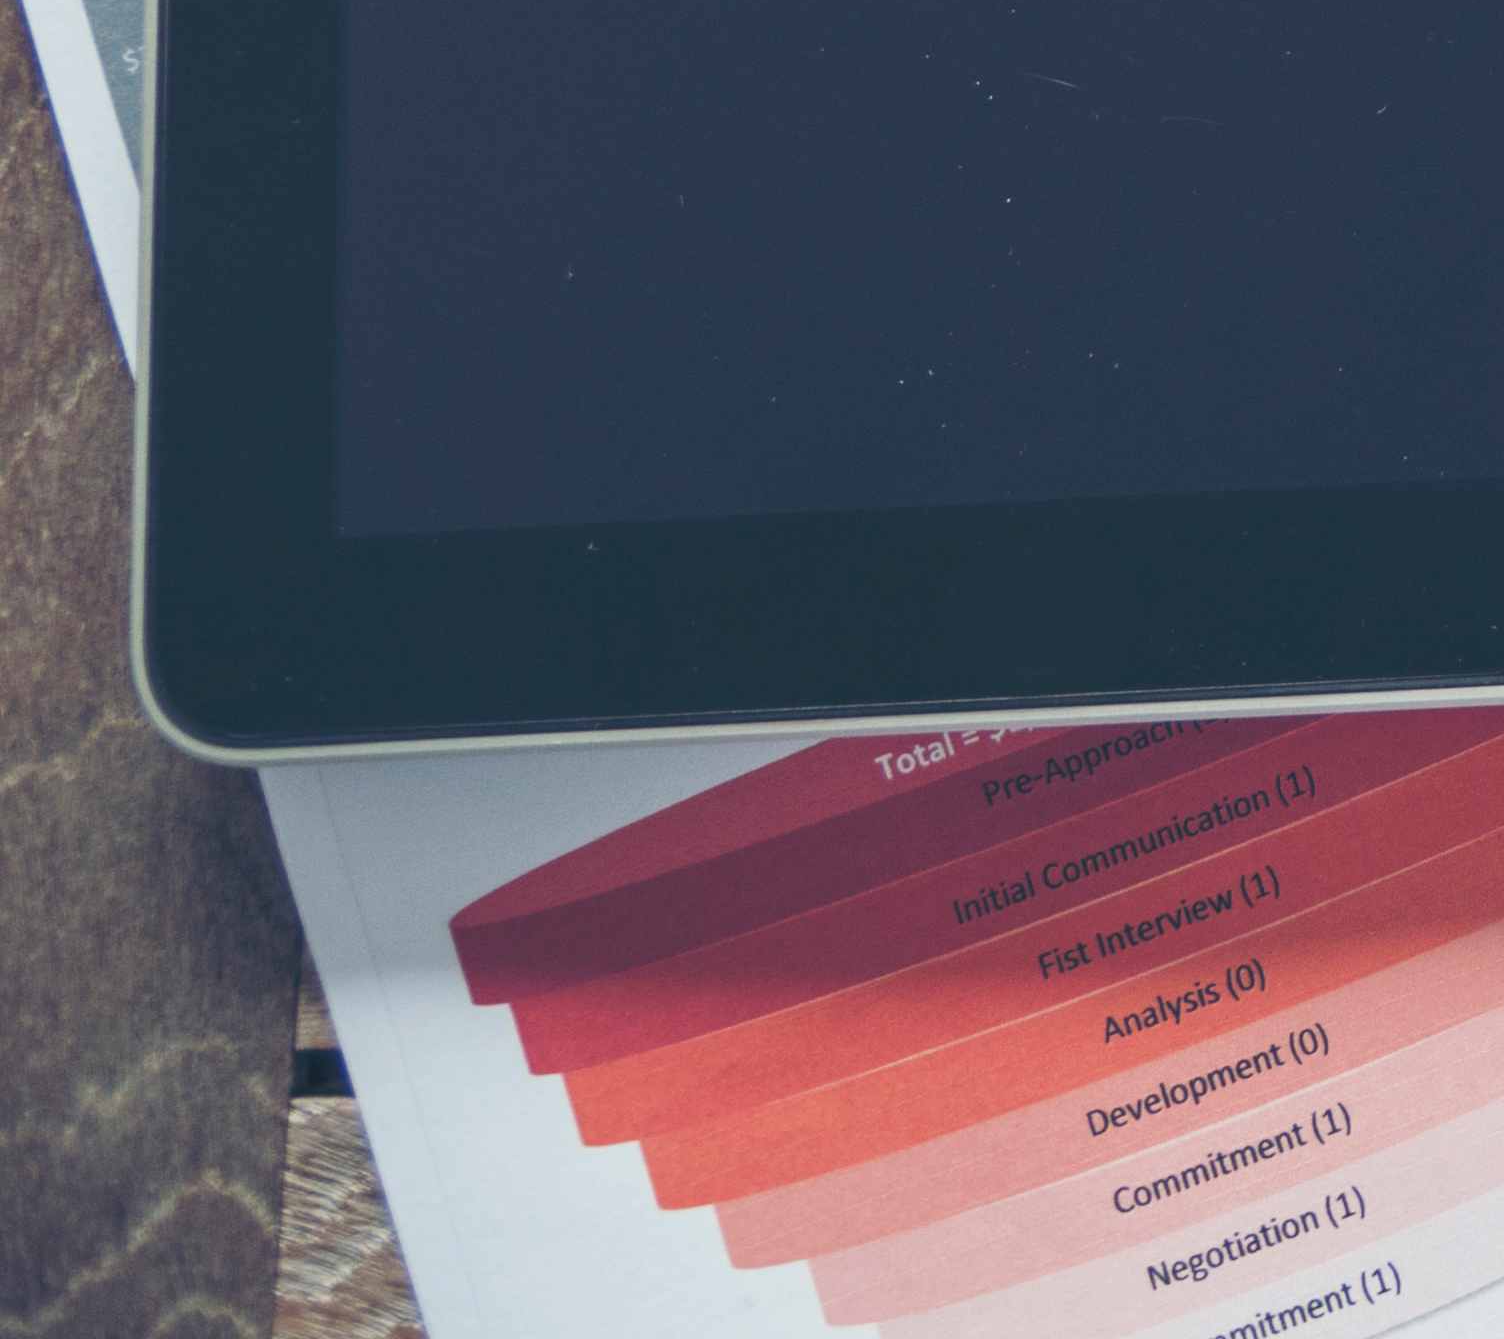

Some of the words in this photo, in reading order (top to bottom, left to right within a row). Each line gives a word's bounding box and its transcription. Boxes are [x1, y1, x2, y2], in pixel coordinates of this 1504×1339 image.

[874, 731, 955, 780] Total
[953, 878, 1033, 923] Initial
[1043, 788, 1270, 891] Communication
[1276, 764, 1316, 800] (1)
[1039, 942, 1090, 979] Fist
[1097, 887, 1234, 951] Interview
[1240, 864, 1280, 900] (1)
[1103, 981, 1220, 1045] Analysis
[1226, 957, 1266, 994] (0)
[1086, 1041, 1283, 1137] Development
[1290, 1022, 1328, 1058] (0)
[1112, 1123, 1306, 1214] Commitment
[1311, 1102, 1351, 1138] (1)
[1146, 1207, 1320, 1292] Negotiation
[1326, 1186, 1366, 1221] (1)
